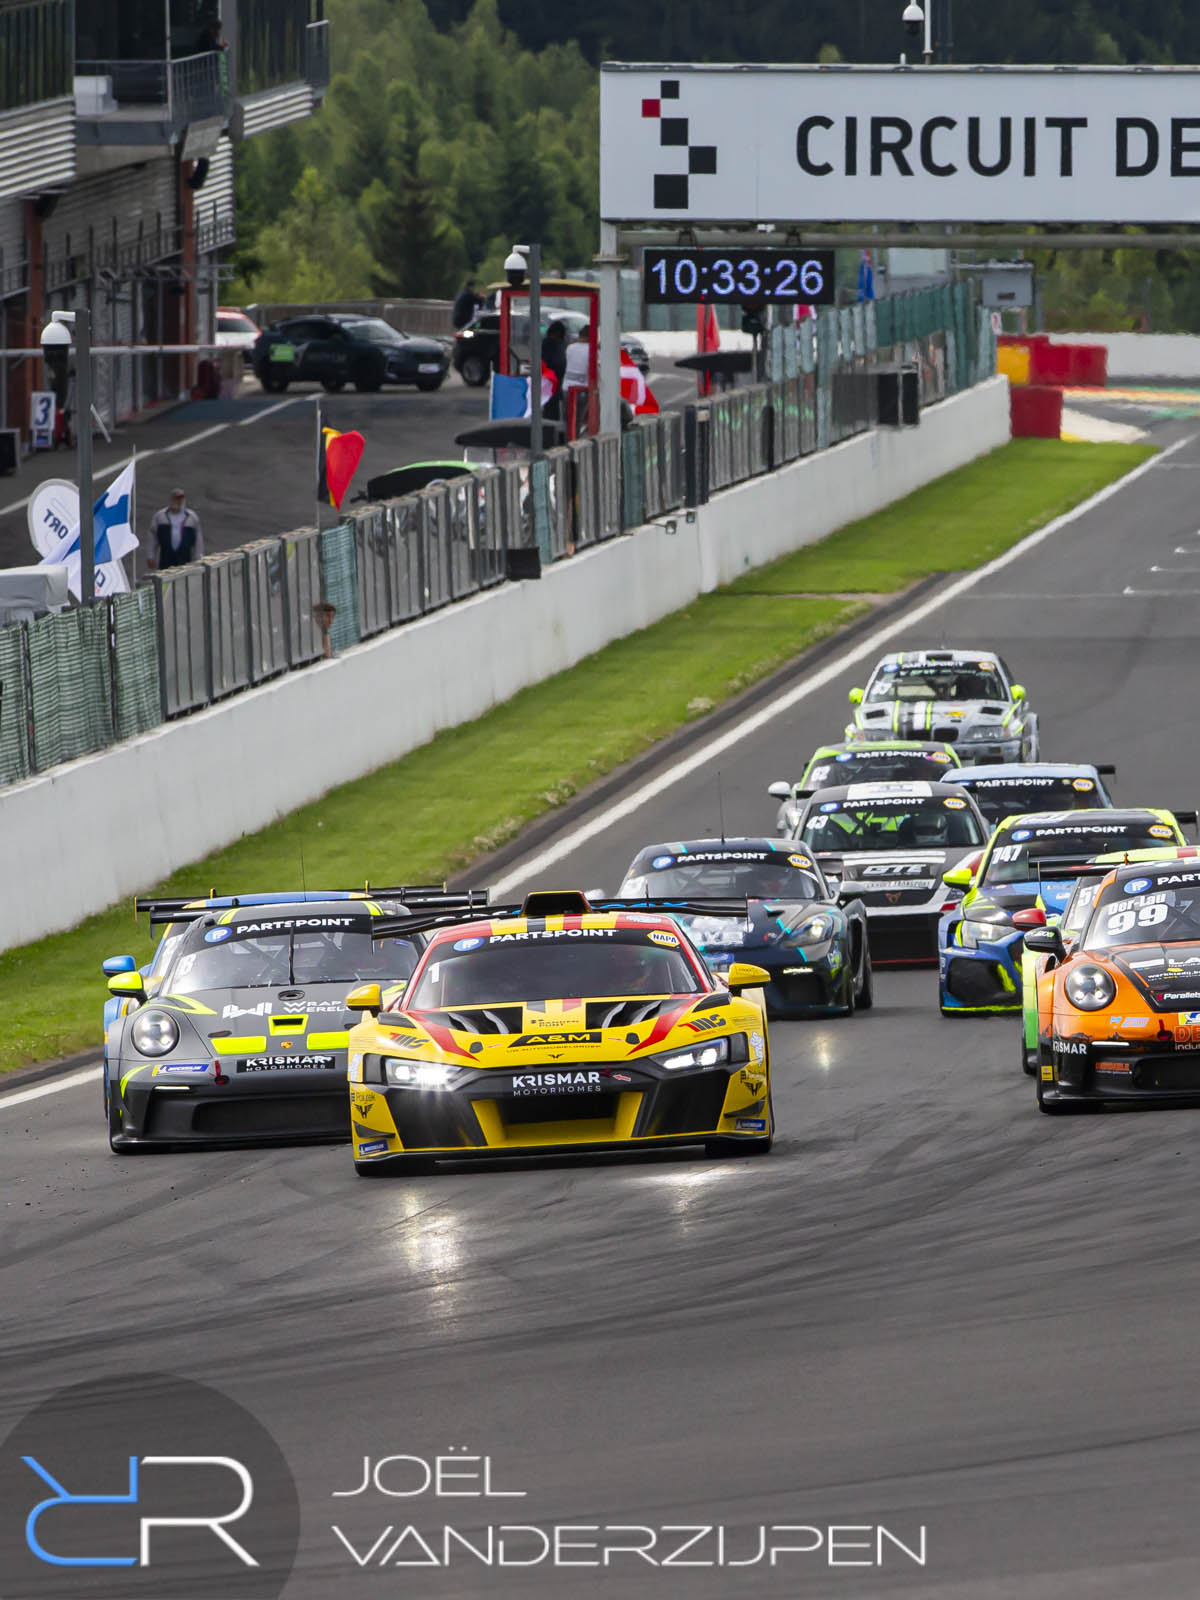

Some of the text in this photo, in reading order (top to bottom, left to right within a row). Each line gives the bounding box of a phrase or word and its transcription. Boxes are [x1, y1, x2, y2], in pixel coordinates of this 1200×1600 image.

[796, 115, 1088, 178] CIRCUIT
[652, 259, 823, 295] 10:33:26
[35, 397, 50, 426] 3
[855, 750, 927, 759] PARTSPOINT
[976, 778, 1055, 787] PARTSPOINT
[842, 798, 925, 809] PARTSPOINT
[806, 815, 829, 830] 43
[1035, 825, 1128, 837] PARTSPOINT
[677, 852, 769, 863] PARTSPOINT
[791, 857, 810, 866] NAPA
[1106, 903, 1169, 936] 99
[236, 917, 355, 935] PARTSPOINT
[489, 929, 617, 944] PARTSPOINT
[652, 933, 677, 944] NAPA
[427, 961, 440, 984] 1
[282, 1005, 351, 1014] WEREL
[246, 1055, 326, 1067] KRISMAR
[246, 1064, 326, 1072] MOTORHOMES
[512, 1071, 601, 1089] KRISMAR
[513, 1085, 601, 1097] MOTORHOMES
